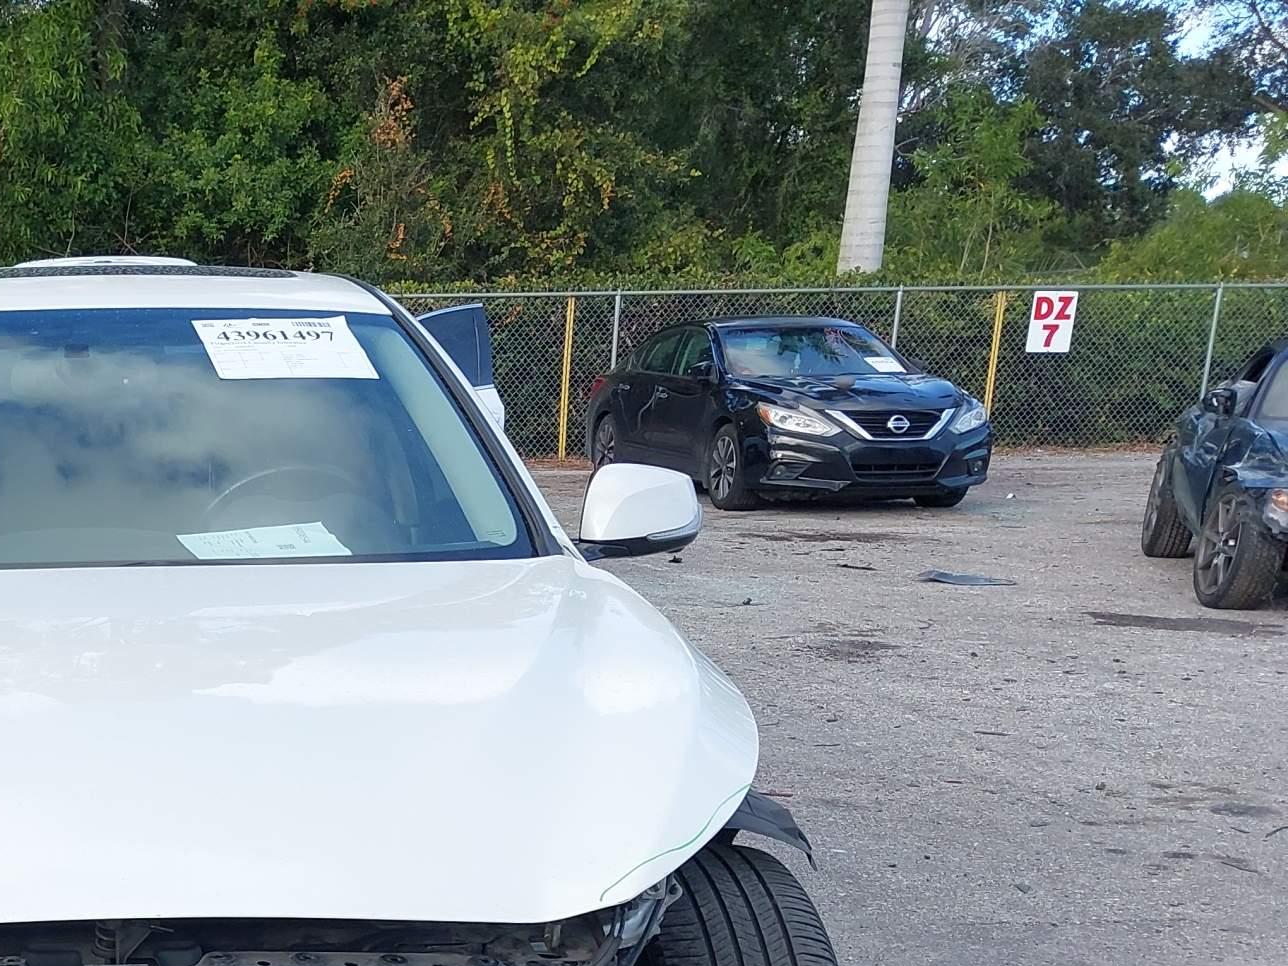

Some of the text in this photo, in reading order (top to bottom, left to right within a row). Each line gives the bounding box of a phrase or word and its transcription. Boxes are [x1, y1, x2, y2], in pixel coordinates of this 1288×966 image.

[1033, 296, 1075, 321] DZ
[217, 330, 334, 341] 43961497
[1042, 324, 1060, 348] 7
